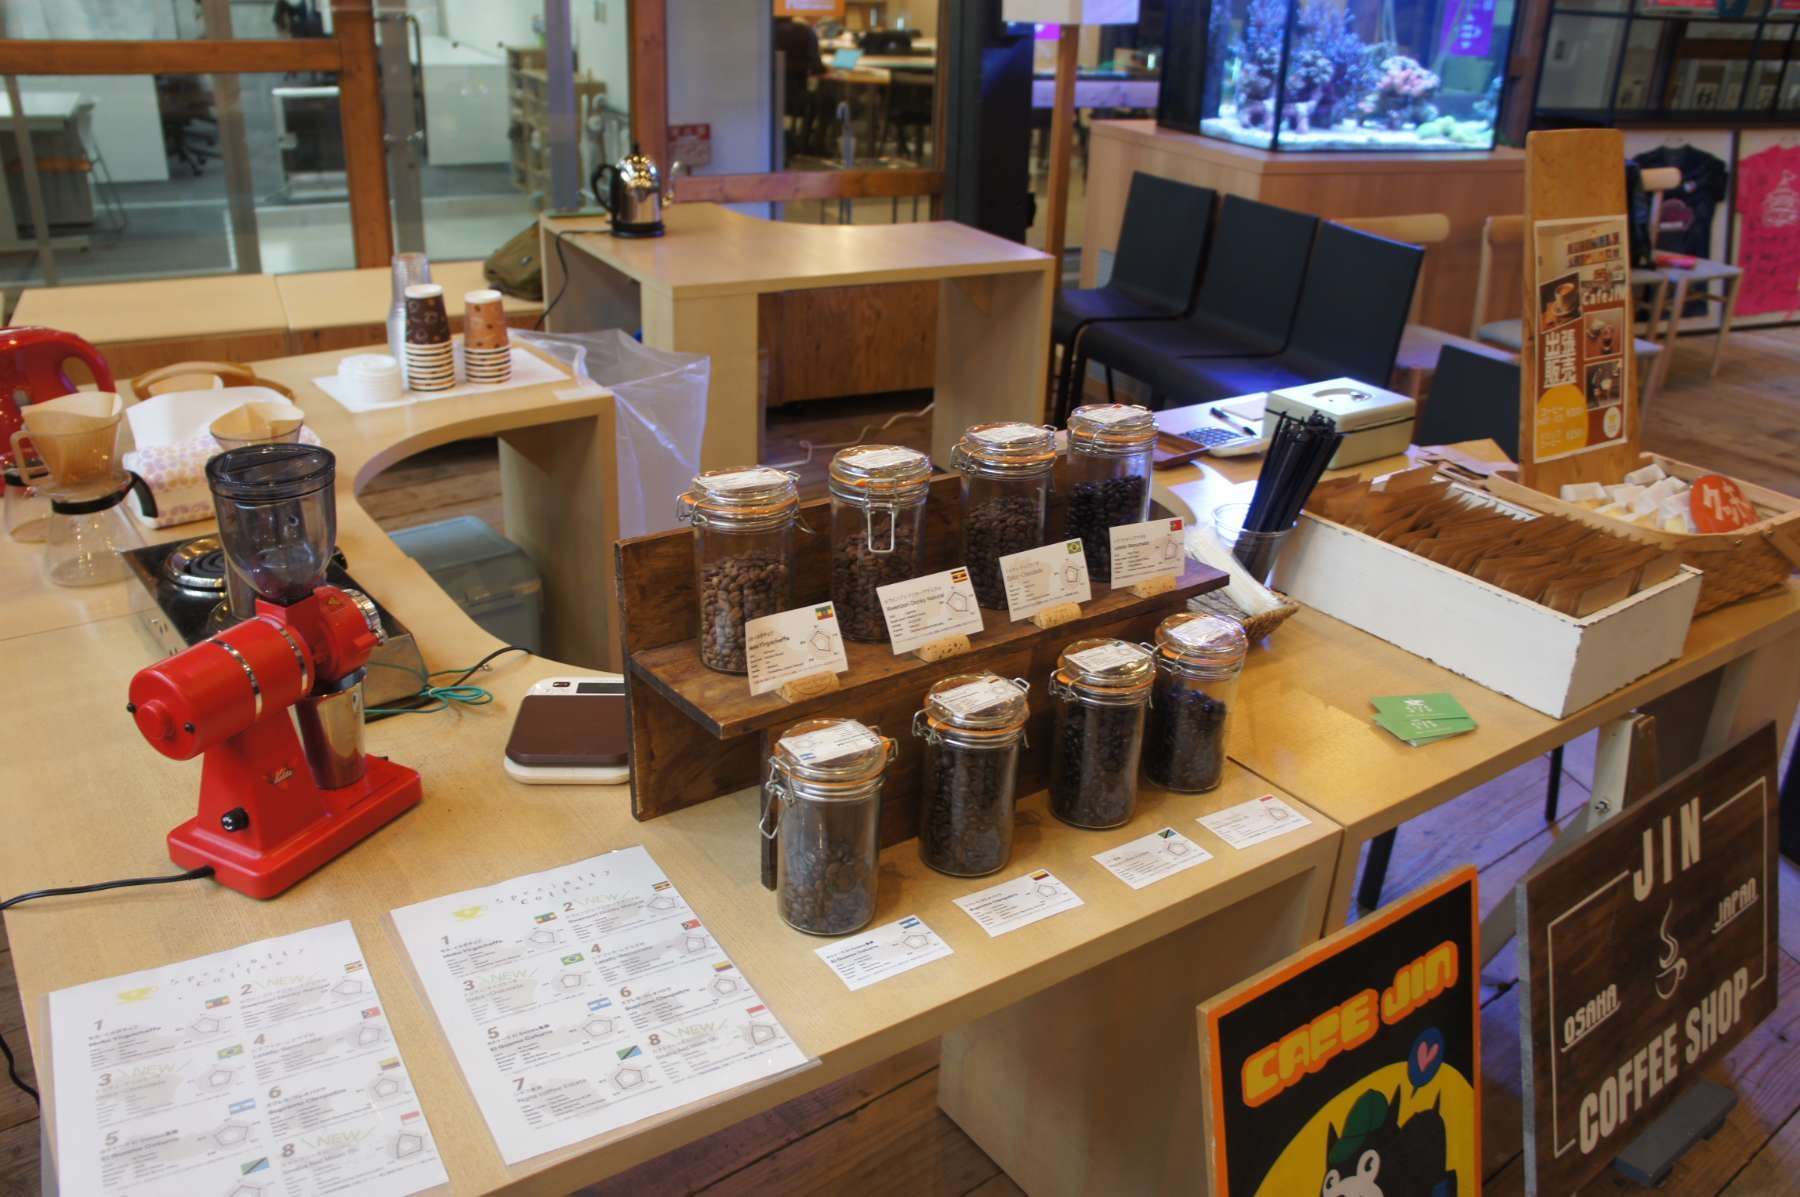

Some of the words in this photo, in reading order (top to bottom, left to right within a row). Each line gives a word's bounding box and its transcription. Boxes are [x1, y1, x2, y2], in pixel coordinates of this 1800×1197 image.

[1633, 797, 1701, 902] JIN
[563, 902, 575, 912] 2
[1714, 877, 1758, 929] JAPAN
[440, 935, 449, 945] 1
[591, 943, 601, 953] 4
[240, 983, 253, 996] 2
[463, 979, 475, 991] 3
[620, 986, 632, 998] 6
[1564, 983, 1618, 1047] OSAKA
[93, 1019, 104, 1031] 1
[253, 1033, 266, 1045] 4
[487, 1026, 500, 1040] 5
[648, 1033, 661, 1046] 8
[1242, 988, 1379, 1107] CAFE
[1579, 1022, 1679, 1155] COFFEE
[1685, 966, 1749, 1065] SHOP
[97, 1072, 113, 1087] 3
[512, 1077, 525, 1091] 7
[268, 1086, 282, 1099] 6
[104, 1130, 119, 1146] 5
[281, 1143, 295, 1157] 8
